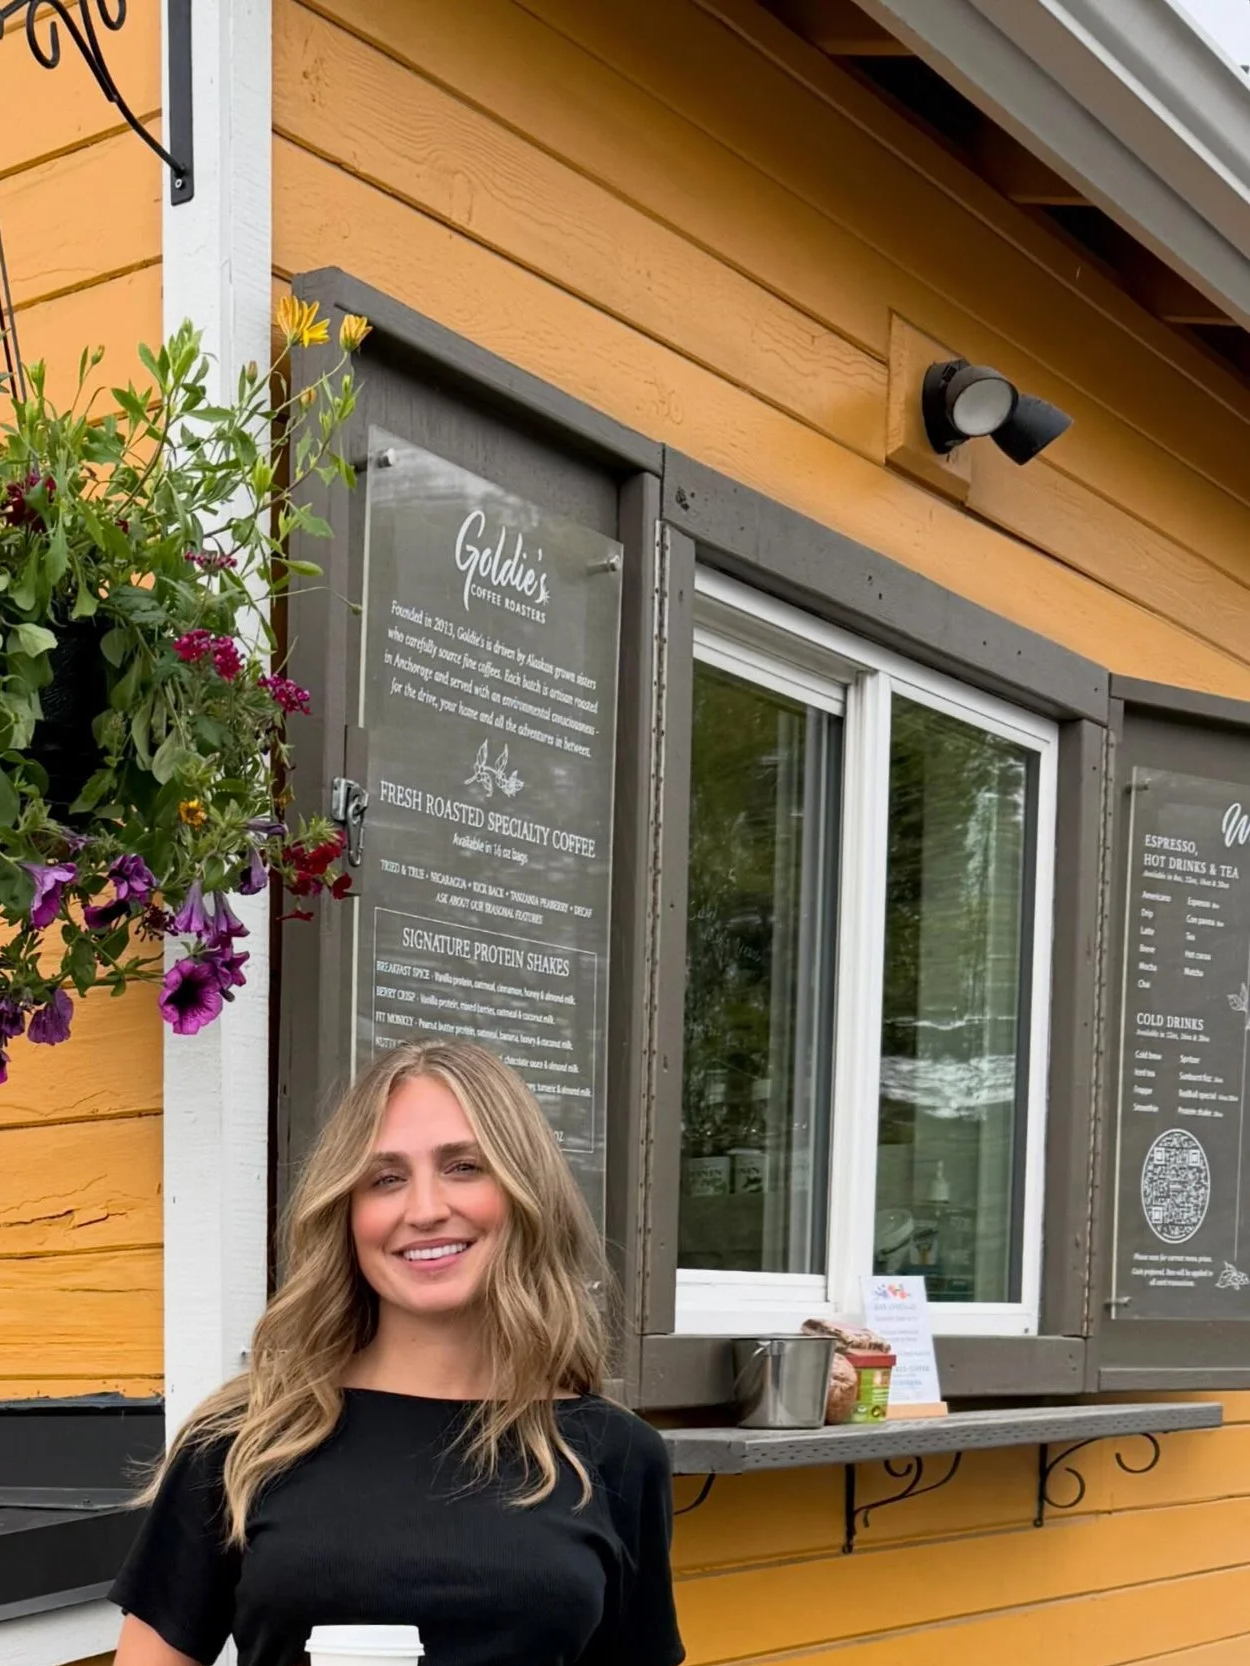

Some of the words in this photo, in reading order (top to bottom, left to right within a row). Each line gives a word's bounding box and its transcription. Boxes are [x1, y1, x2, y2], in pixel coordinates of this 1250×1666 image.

[455, 510, 548, 611] Goldie's
[470, 584, 501, 606] COFFEE
[504, 598, 546, 624] ROASTERS
[388, 626, 404, 643] who
[405, 637, 438, 658] carefully
[438, 648, 462, 665] source
[462, 653, 477, 670] fine
[478, 661, 502, 680] coffees.
[504, 669, 521, 686] Each
[522, 674, 541, 694] batch
[542, 682, 548, 696] is
[550, 688, 573, 704] artisan
[574, 698, 598, 714] roasted
[391, 600, 423, 624] Founded
[424, 612, 432, 628] in
[434, 617, 455, 640] 2013,
[457, 626, 484, 648] Goldie's
[486, 636, 492, 651] is
[493, 640, 515, 660] driven
[517, 648, 526, 666] by
[526, 654, 554, 675] Alaskan
[554, 667, 575, 682] grown
[576, 672, 596, 690] sisters
[384, 648, 392, 664] in
[394, 653, 433, 682] Anchorage
[434, 671, 450, 685] and
[450, 680, 473, 694] served
[474, 684, 490, 700] with
[491, 692, 501, 703] an
[502, 696, 550, 720] environmental
[390, 677, 402, 695] for
[404, 682, 416, 698] the
[418, 687, 438, 709] drive,
[439, 698, 458, 712] your
[458, 701, 478, 720] home
[479, 711, 494, 725] and
[494, 715, 504, 729] all
[506, 717, 516, 733] the
[518, 723, 554, 745] adventures
[555, 735, 562, 748] in
[380, 780, 422, 811] FRESH
[426, 794, 484, 828] ROASTED
[488, 812, 550, 846] SPECIALTY
[552, 830, 596, 858] COFFEE
[452, 832, 484, 852] Available
[485, 840, 492, 854] in
[512, 848, 528, 866] bags
[1144, 853, 1166, 868] HOT
[1169, 857, 1207, 874] DRINKS
[1210, 863, 1217, 876] &
[1220, 865, 1240, 880] TEA
[1145, 834, 1198, 857] ESPRESSO,
[449, 895, 470, 909] ABOUT
[402, 927, 471, 959] SIGNATURE
[474, 942, 524, 969] PROTEIN
[526, 952, 570, 977] SHAKES
[1136, 1012, 1164, 1026] COLD
[1166, 1015, 1204, 1031] DRINKS
